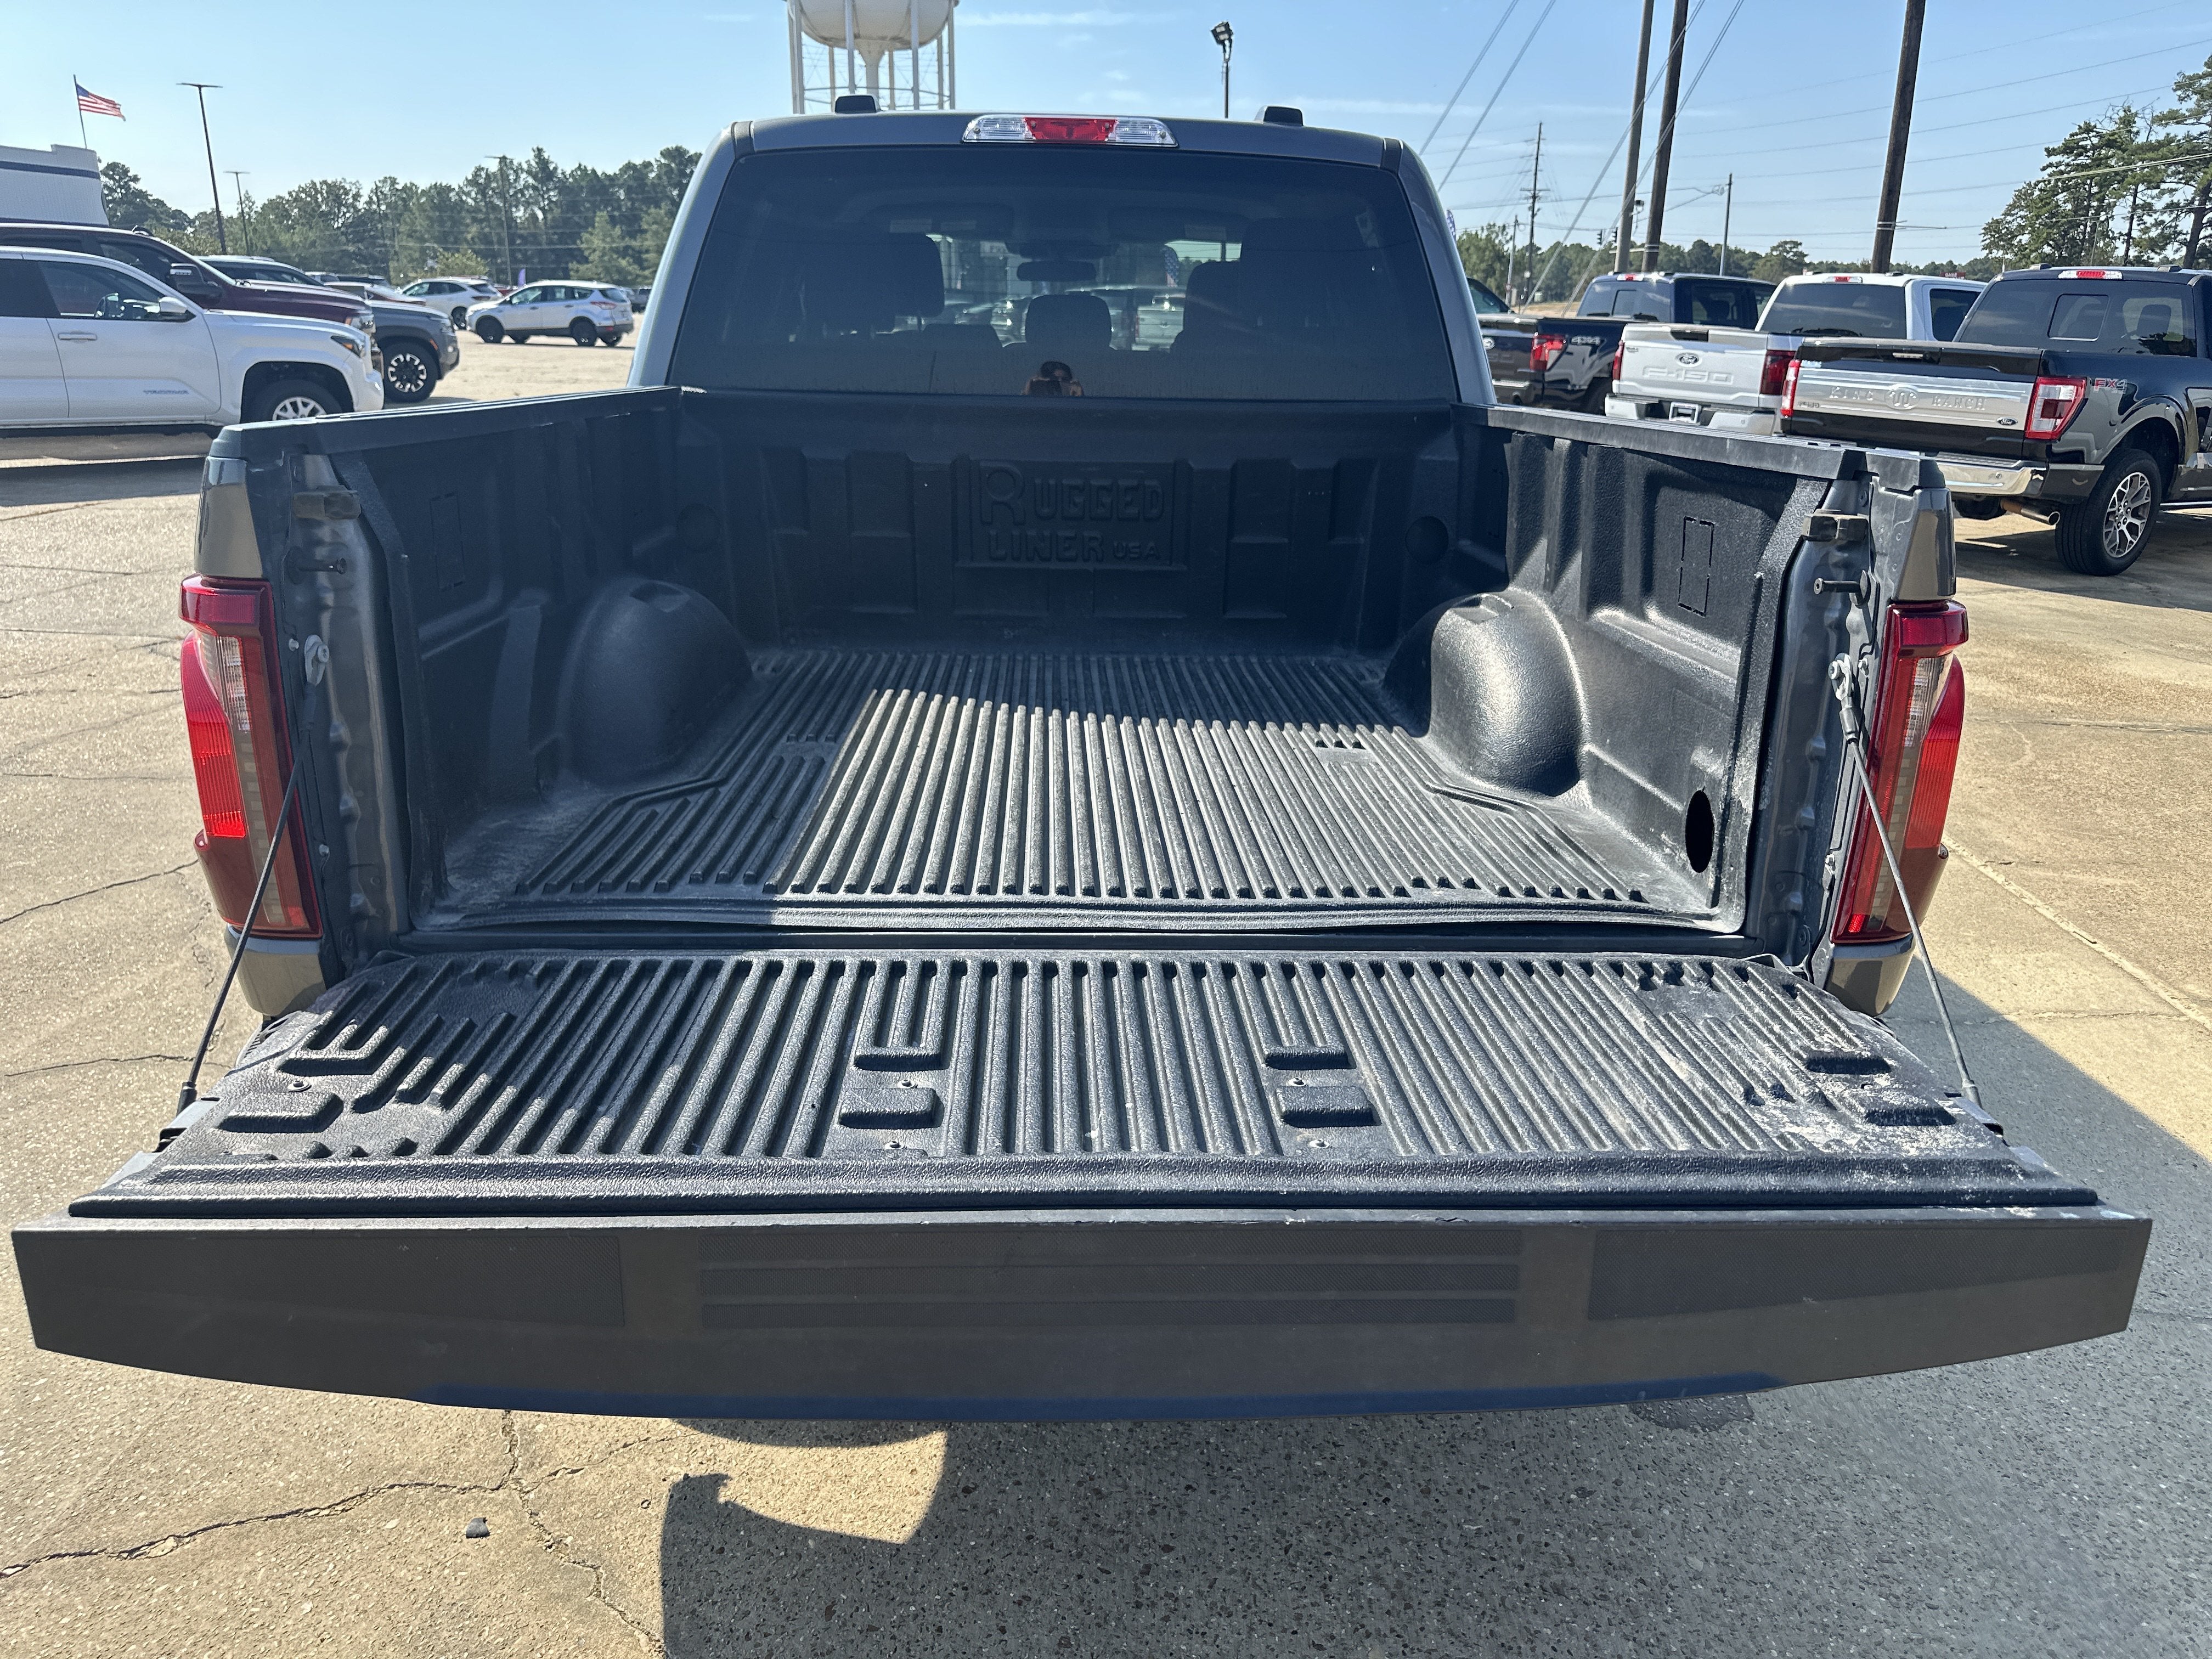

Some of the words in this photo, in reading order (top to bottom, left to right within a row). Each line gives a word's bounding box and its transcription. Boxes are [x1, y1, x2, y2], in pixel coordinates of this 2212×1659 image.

[1643, 366, 1734, 385] F-150
[2094, 377, 2127, 393] FX4
[1932, 396, 1987, 410] RANCH
[980, 460, 1165, 525] RUGGED
[989, 528, 1104, 562] LINER
[1113, 540, 1160, 560] USA
